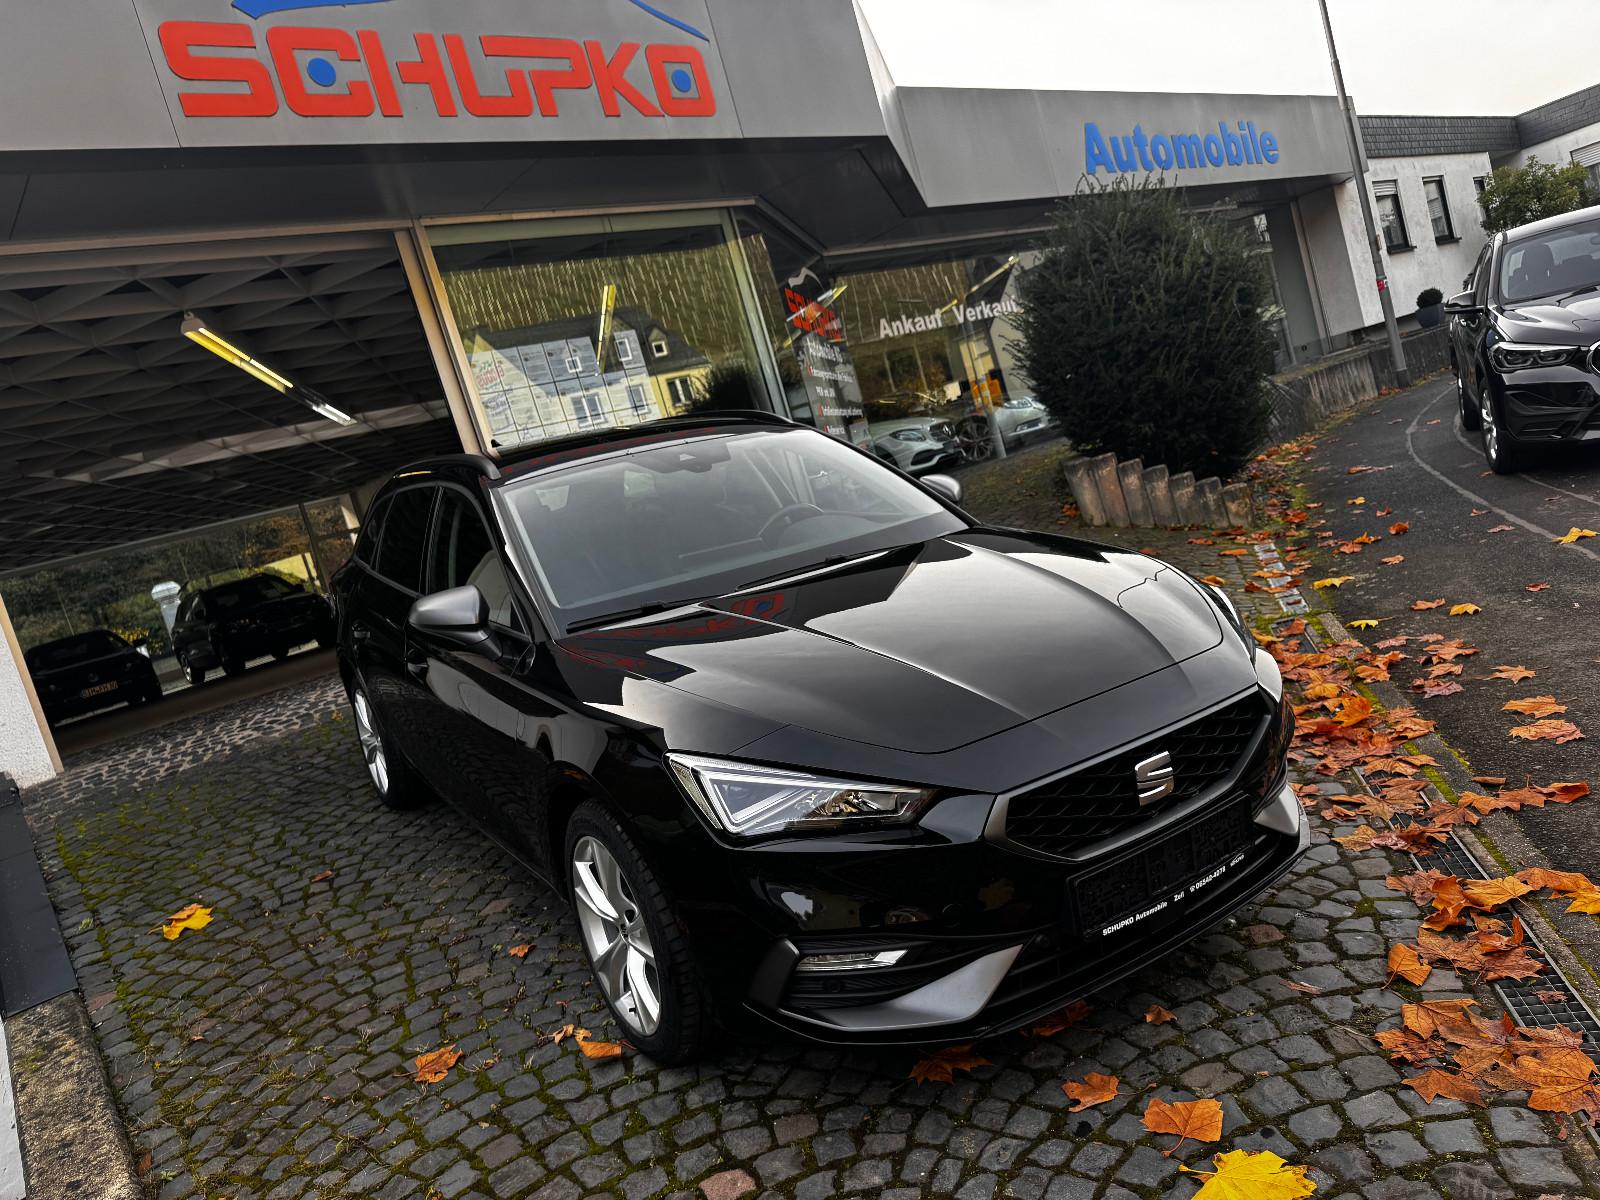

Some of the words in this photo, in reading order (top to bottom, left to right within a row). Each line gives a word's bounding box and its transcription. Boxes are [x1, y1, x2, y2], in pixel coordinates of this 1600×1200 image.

[157, 20, 717, 118] SCHUPKO
[1083, 119, 1281, 176] Automobile
[879, 307, 943, 339] Ankauf
[1102, 916, 1134, 937] SCHUPKO
